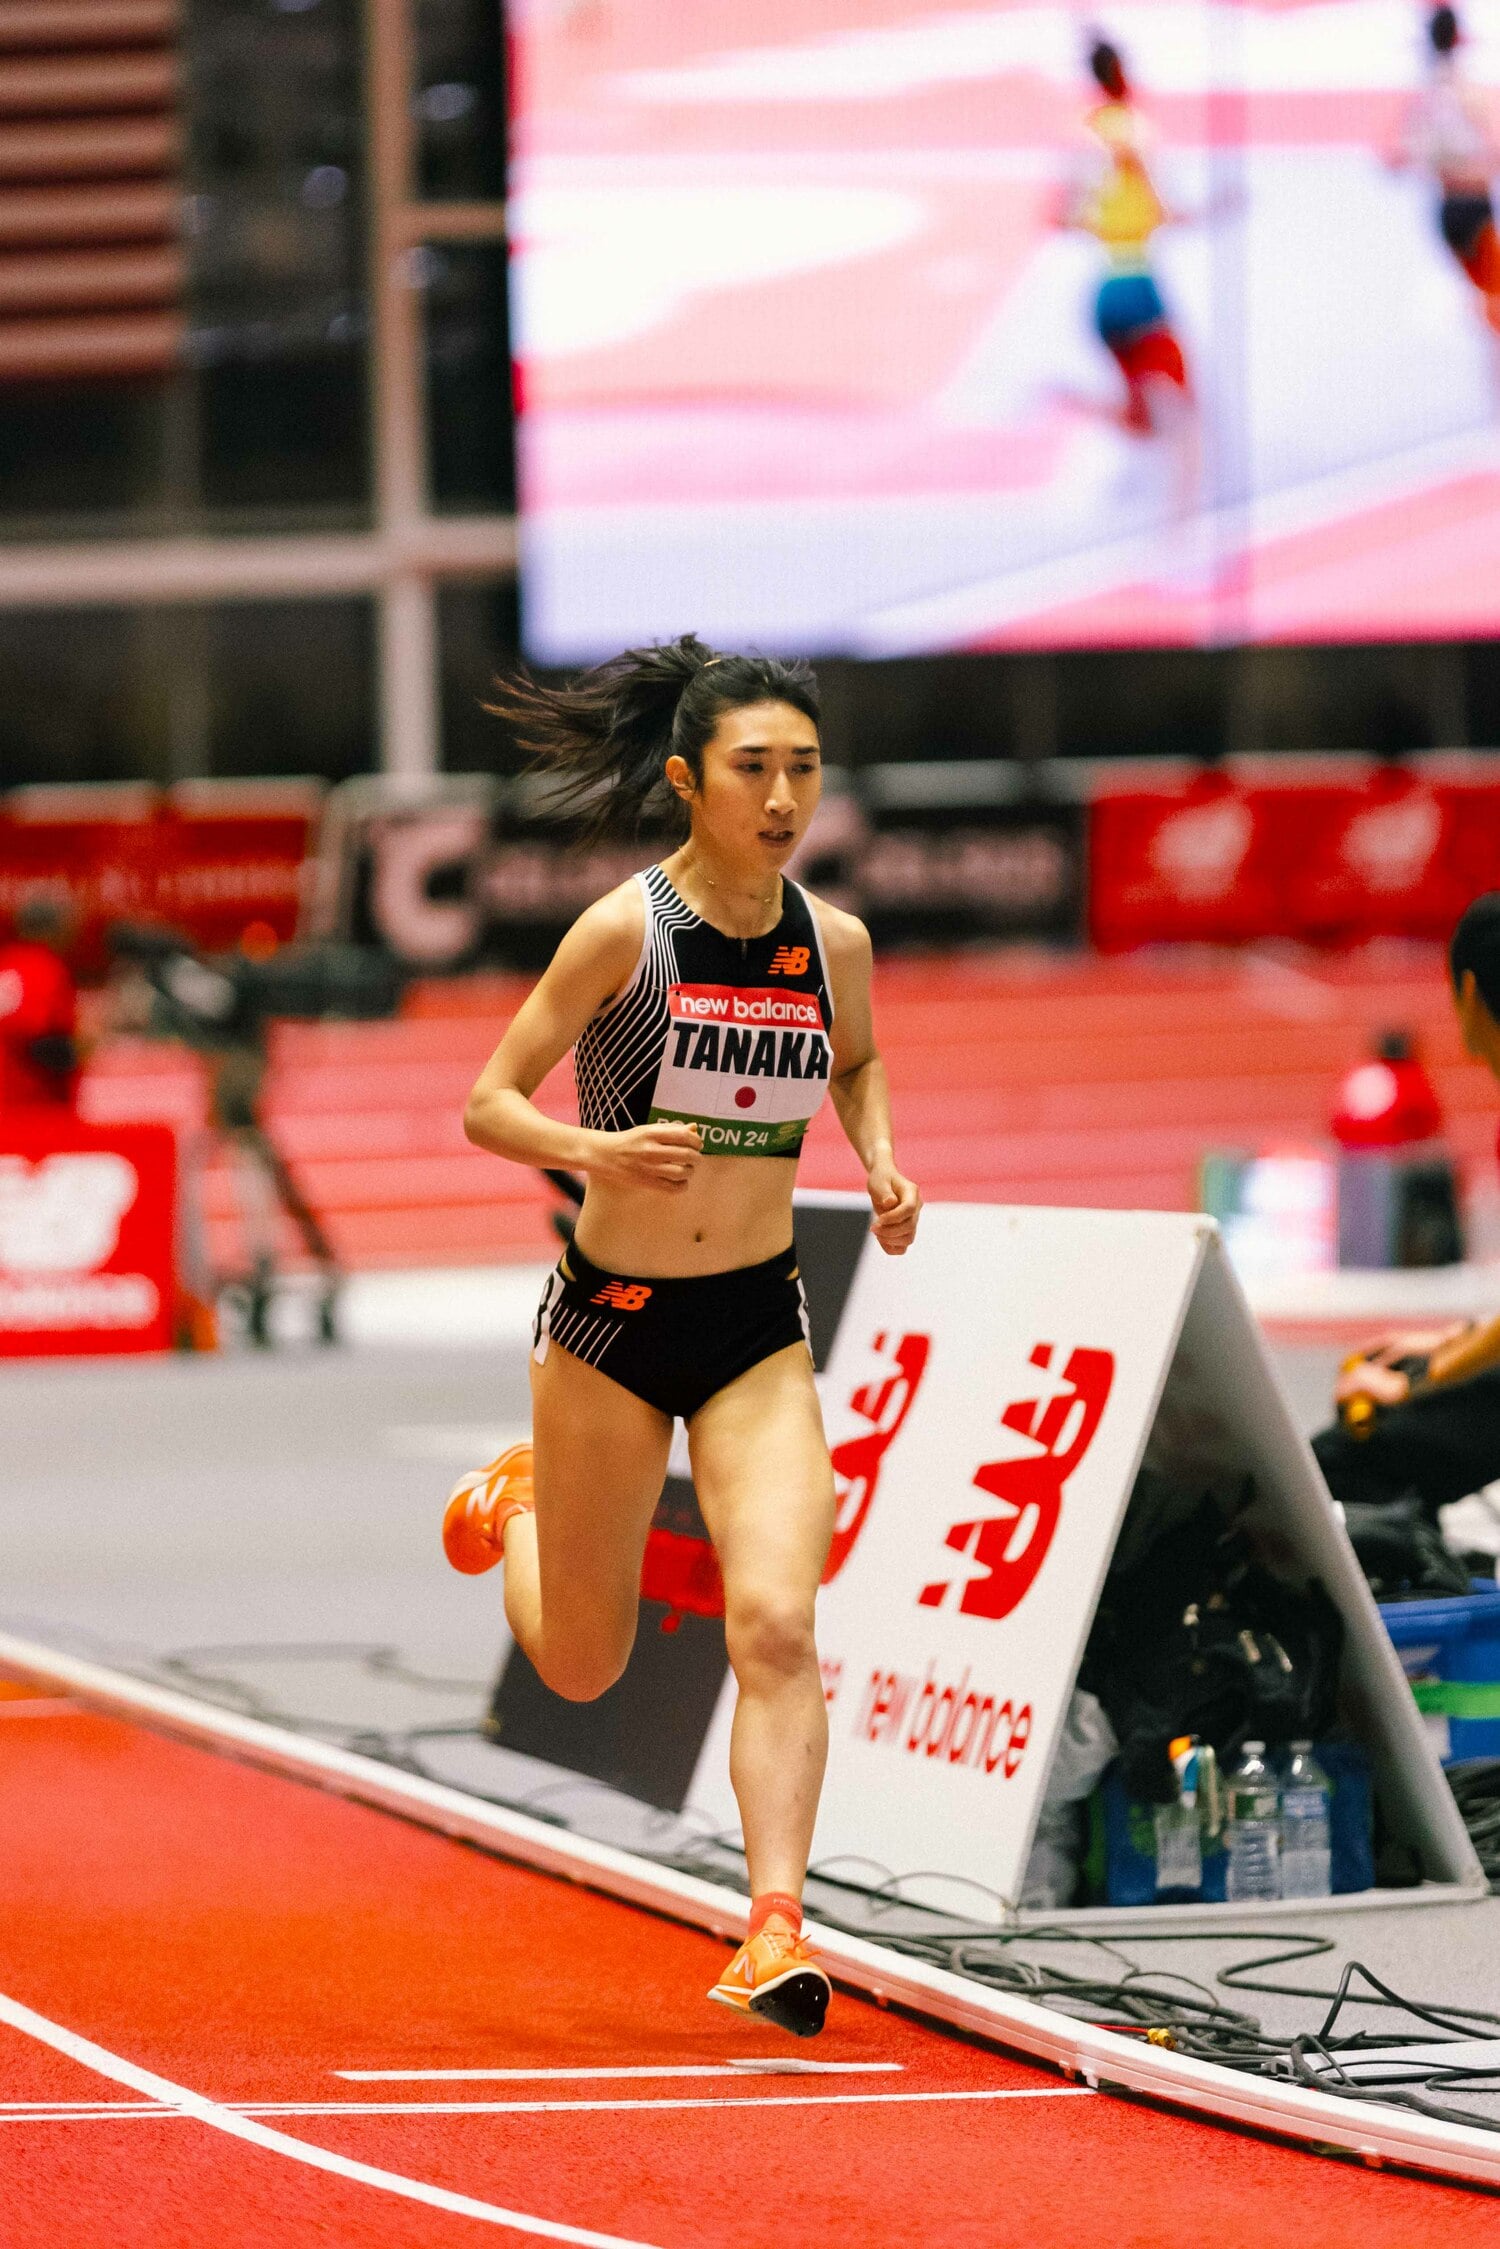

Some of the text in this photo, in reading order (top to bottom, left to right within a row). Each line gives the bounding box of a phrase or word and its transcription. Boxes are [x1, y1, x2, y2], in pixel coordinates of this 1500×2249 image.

[768, 946, 810, 975] NB
[681, 996, 817, 1023] new balance
[673, 1022, 829, 1079] TANAKA
[657, 1118, 769, 1147] TON 24
[590, 1281, 652, 1311] NB
[466, 1475, 508, 1517] N
[918, 1344, 1114, 1620] NB
[855, 1668, 917, 1745] new
[907, 1657, 1033, 1779] balance
[733, 1952, 757, 1984] N
